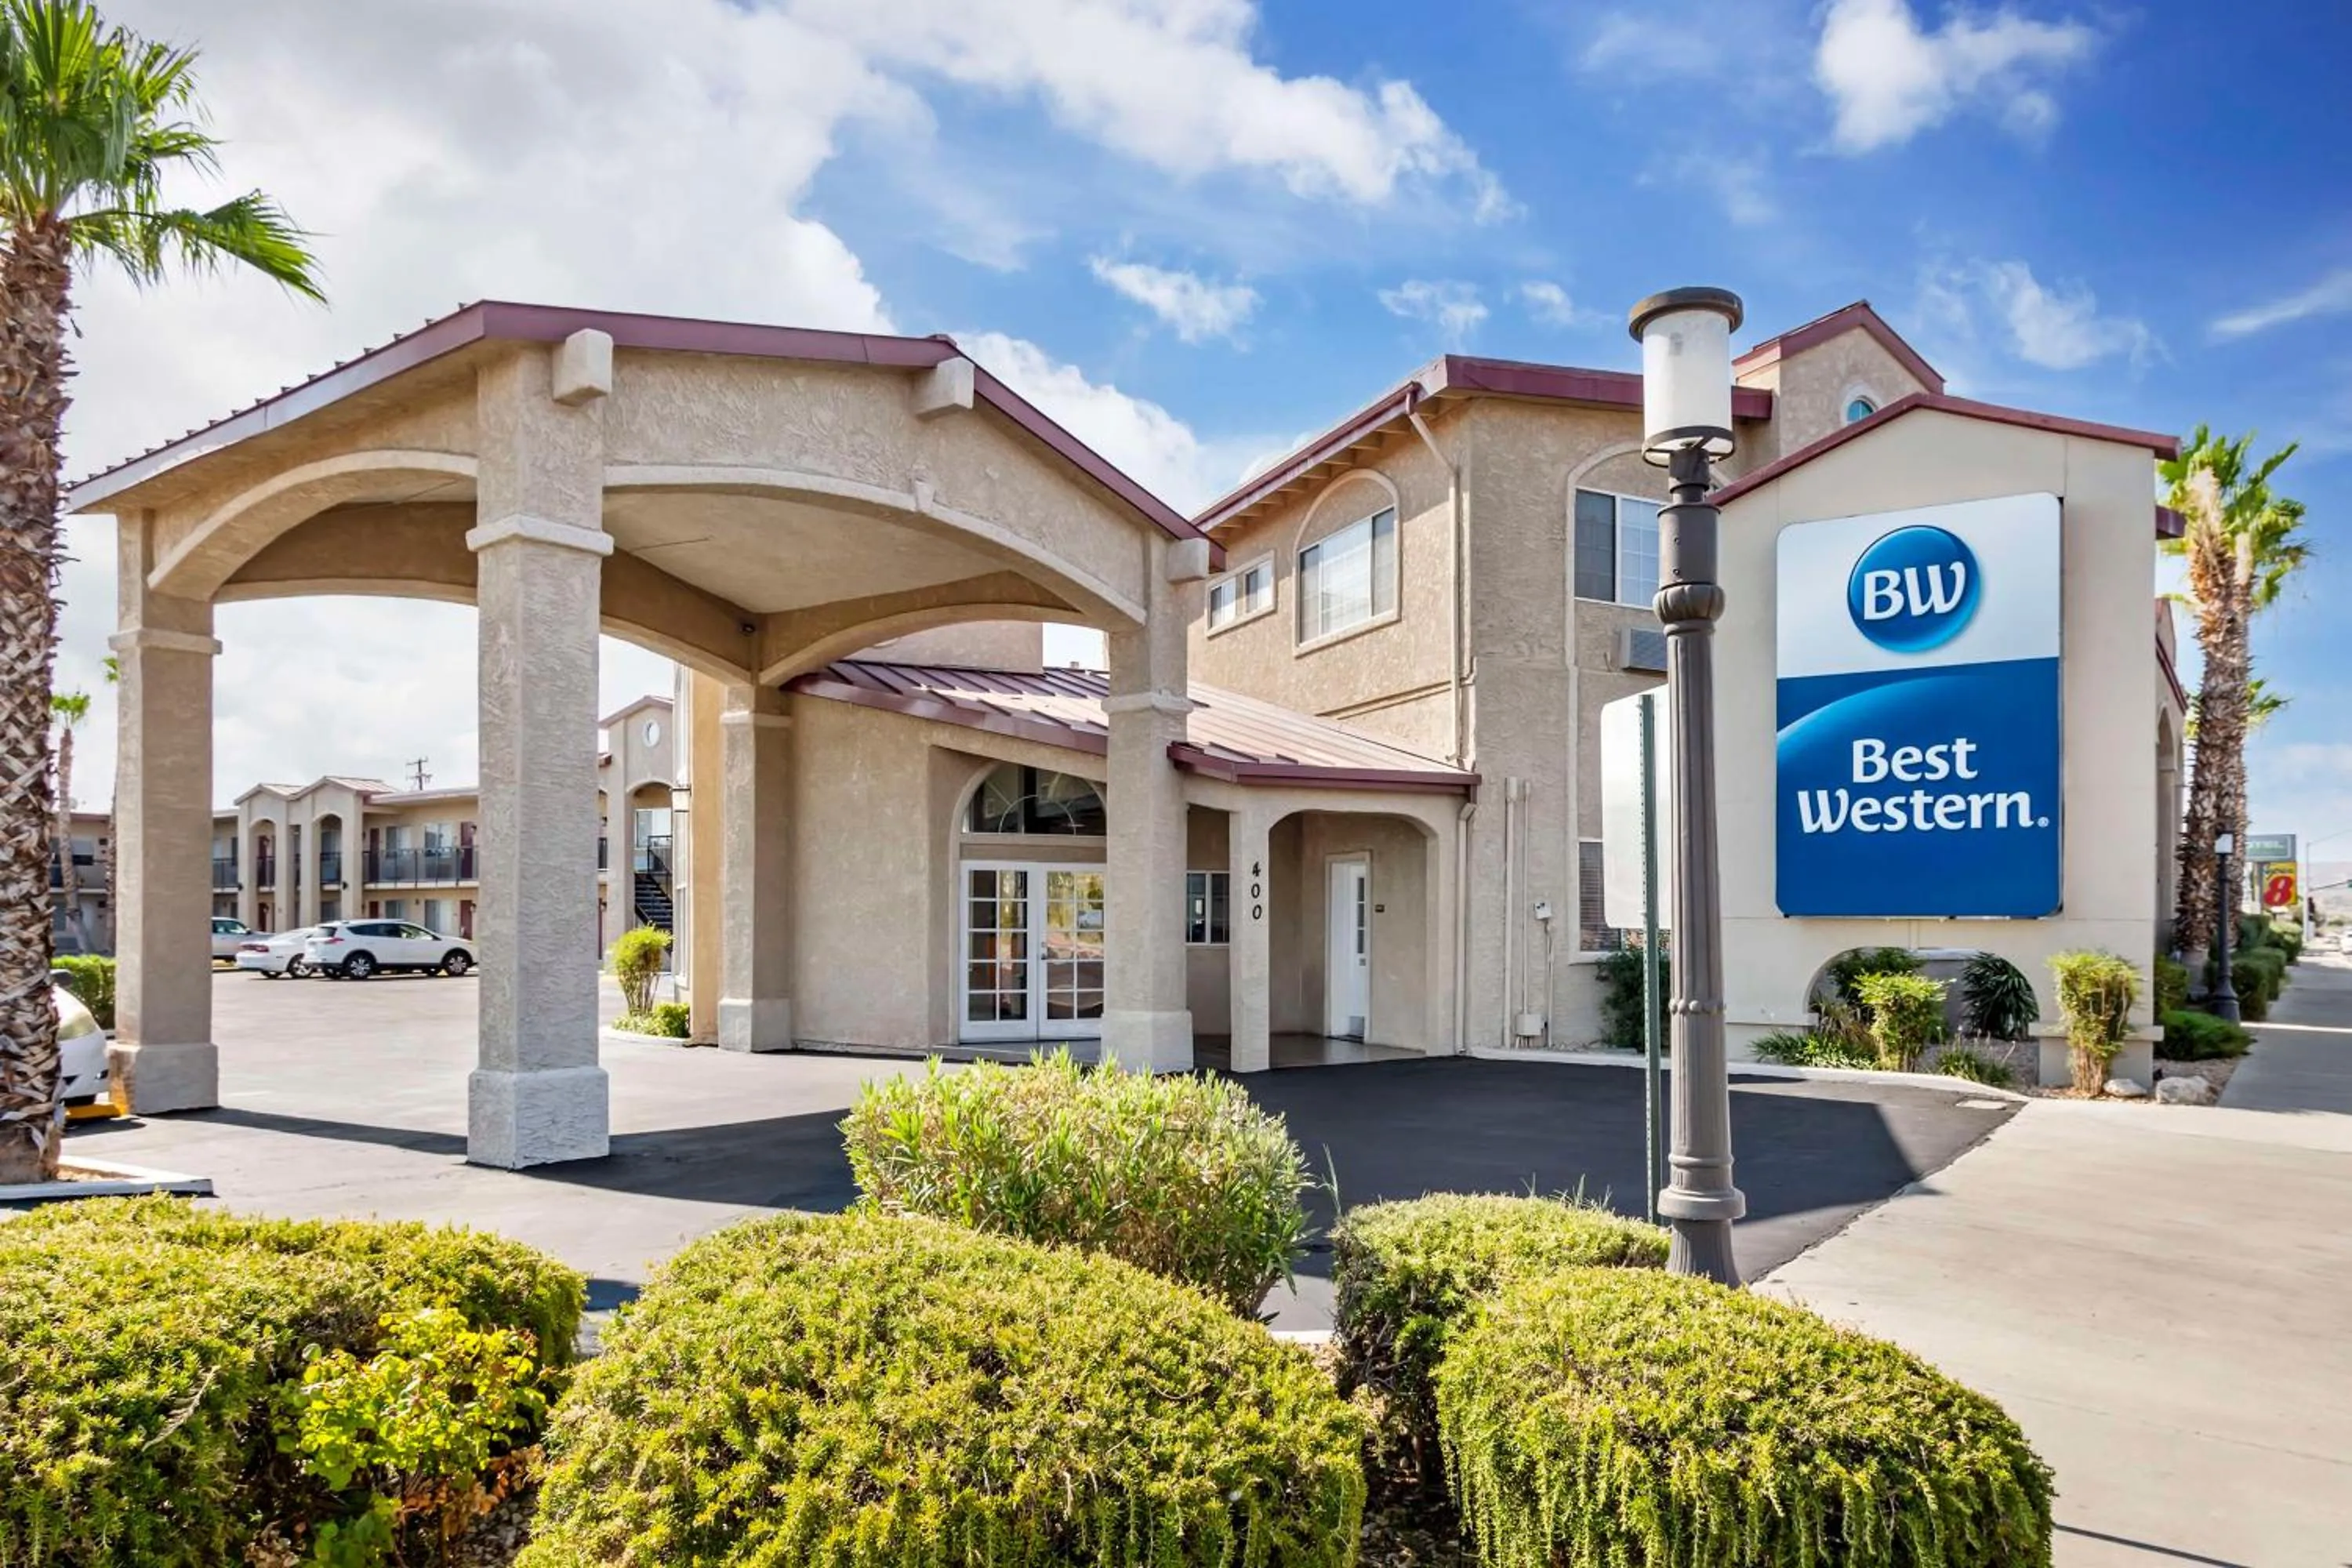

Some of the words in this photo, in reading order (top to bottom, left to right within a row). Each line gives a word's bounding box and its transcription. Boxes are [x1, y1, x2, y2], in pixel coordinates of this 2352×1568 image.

[1863, 561, 1965, 620] BW
[1853, 738, 1978, 783] Best
[1251, 862, 1262, 920] 400
[2263, 875, 2293, 906] 8
